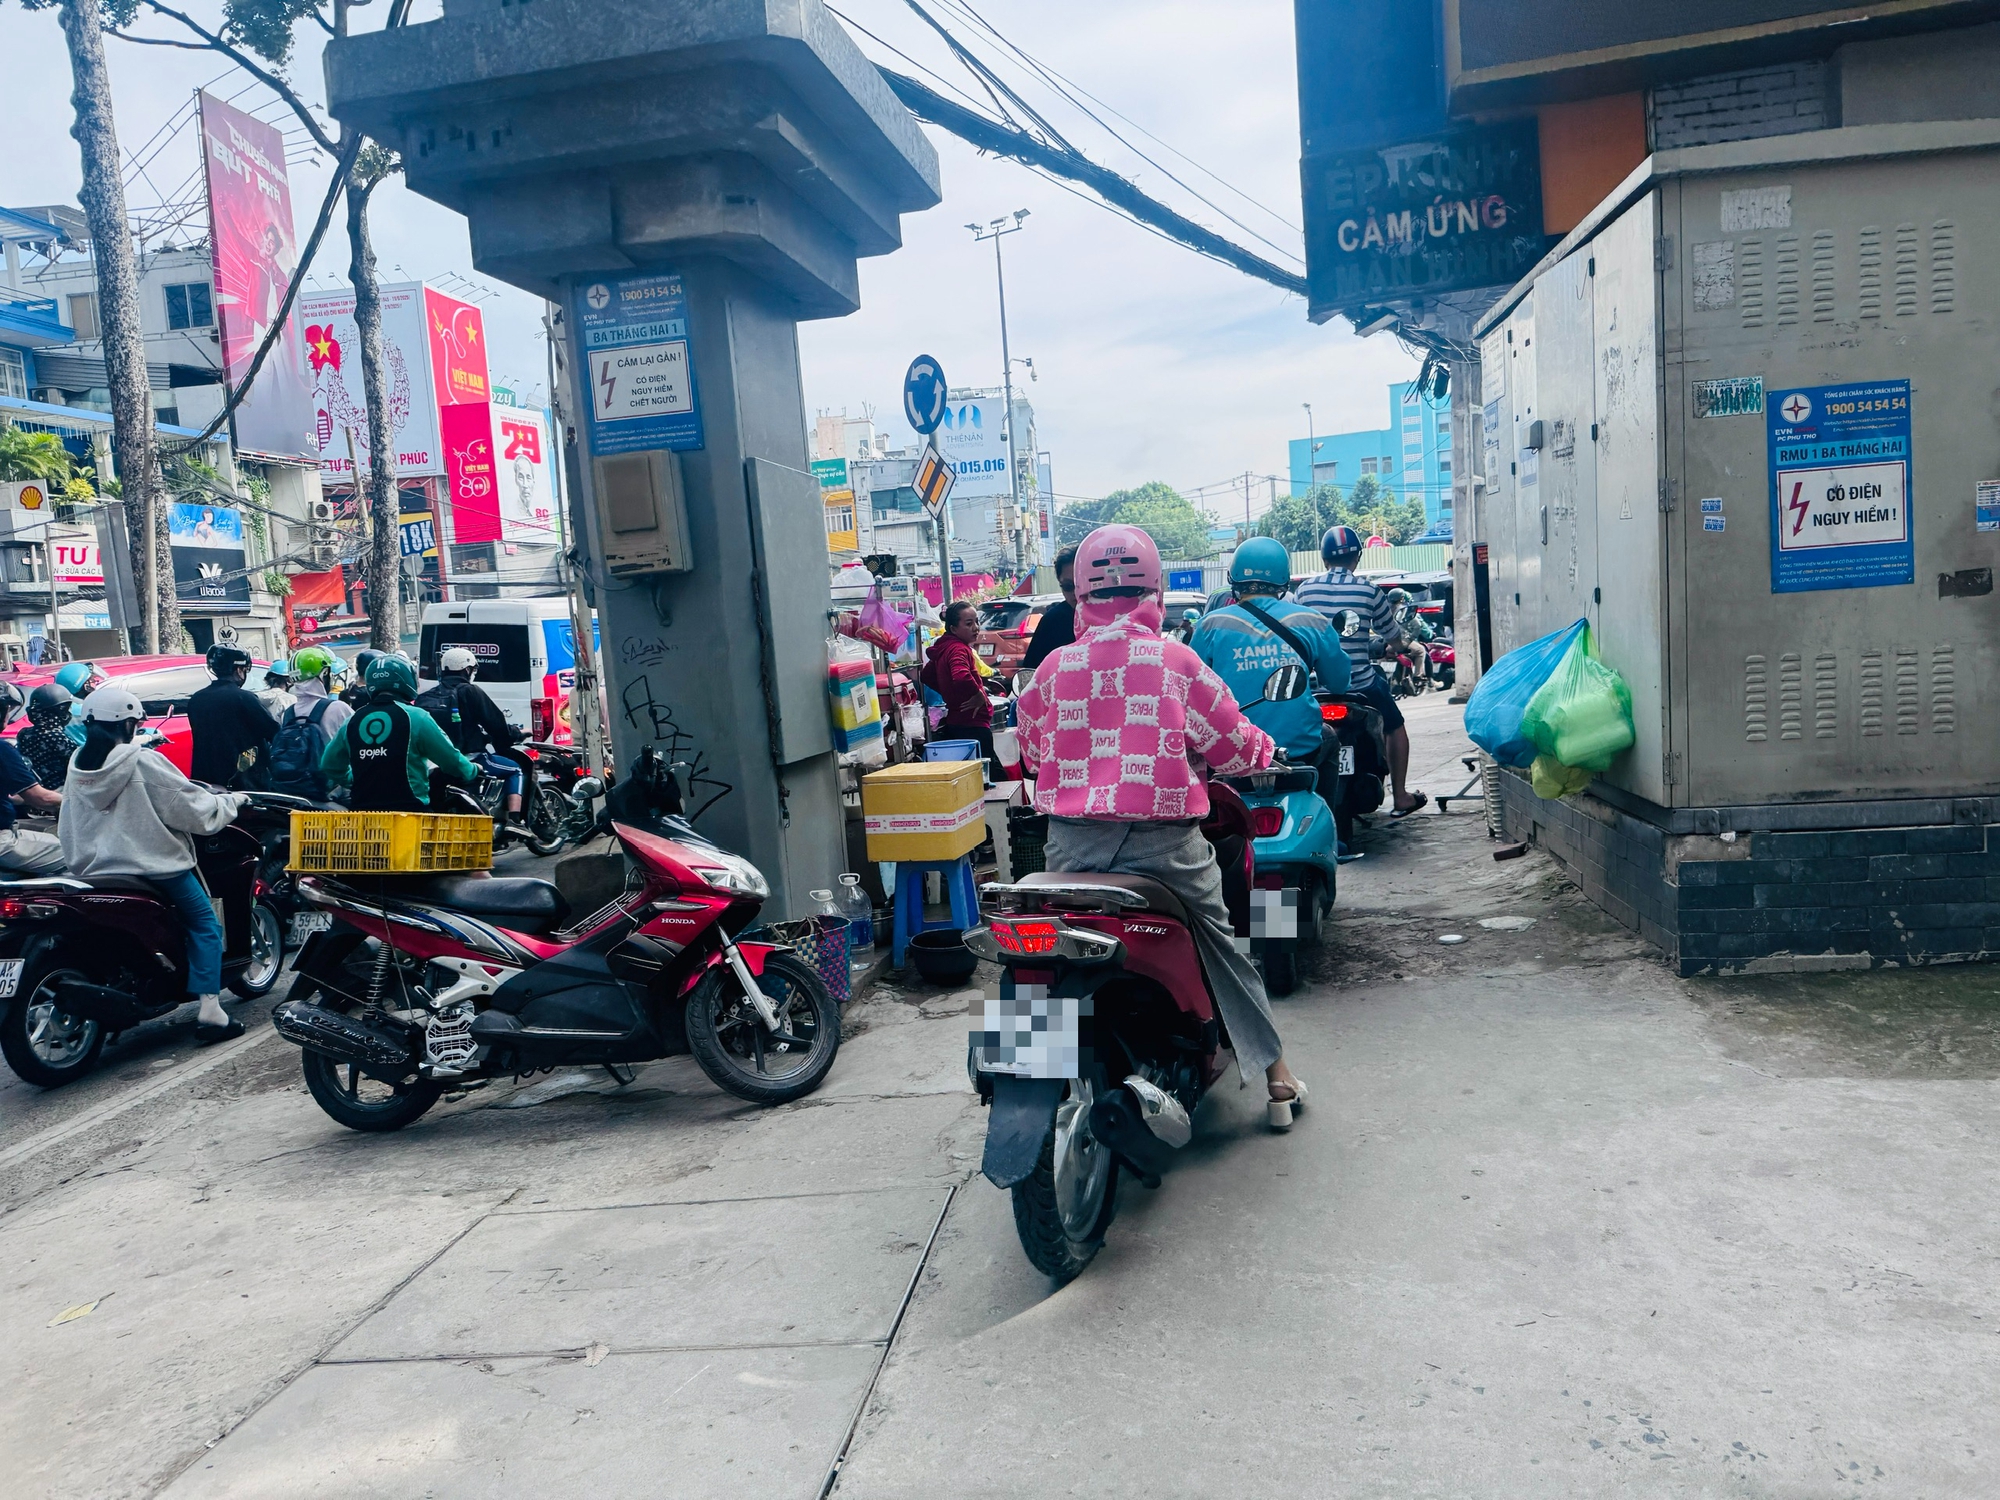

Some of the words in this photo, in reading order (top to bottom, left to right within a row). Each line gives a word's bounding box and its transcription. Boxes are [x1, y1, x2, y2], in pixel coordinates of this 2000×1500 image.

[1337, 206, 1412, 252] CẢM
[1427, 194, 1507, 238] ỨNG
[620, 290, 643, 301] 1900
[644, 288, 656, 299] 54
[657, 286, 669, 297] 54
[670, 284, 682, 295] 54
[593, 331, 608, 344] BA
[610, 324, 647, 341] THÁNG
[650, 324, 669, 337] HAI
[672, 323, 677, 334] 1
[640, 356, 654, 367] LẠI
[468, 372, 485, 390] NAM
[636, 375, 647, 385] CÓ
[649, 374, 667, 384] ĐIỆN
[631, 387, 653, 396] NGUY
[1825, 402, 1855, 415] 1900
[1857, 400, 1873, 413] 54
[1874, 398, 1890, 411] 54
[1891, 396, 1907, 410] 54
[1774, 428, 1793, 436] EVN
[1777, 434, 1786, 442] PC
[400, 450, 429, 466] PHÚC
[1780, 448, 1809, 462] RMU
[1812, 448, 1818, 459] 1
[1822, 446, 1837, 459] BA
[1840, 442, 1879, 458] THÁNG
[1882, 441, 1902, 453] HAI
[951, 458, 1005, 475] 1.015.016
[1827, 484, 1845, 502] CÓ
[1849, 482, 1882, 501] ĐIỆN
[1813, 511, 1851, 527] NGUY
[1854, 504, 1889, 524] HIỂM
[1892, 508, 1897, 521] !
[56, 545, 89, 565] TƯ
[65, 565, 79, 575] SỬA
[81, 566, 96, 575] CÁC
[199, 586, 226, 597] Wacoal
[1063, 652, 1085, 663] PEACE
[1134, 646, 1160, 657] LOVE
[1232, 644, 1278, 660] XANH
[1236, 659, 1258, 672] xin
[372, 671, 390, 679] Grab
[1061, 708, 1084, 721] LOVE
[1129, 703, 1154, 716] PEACE
[1095, 736, 1116, 748] PLAY
[359, 746, 388, 759] gojek
[1063, 768, 1084, 780] PEACE
[1125, 763, 1150, 776] LOVE
[1159, 790, 1186, 803] SWEET
[1122, 923, 1168, 935] VISION
